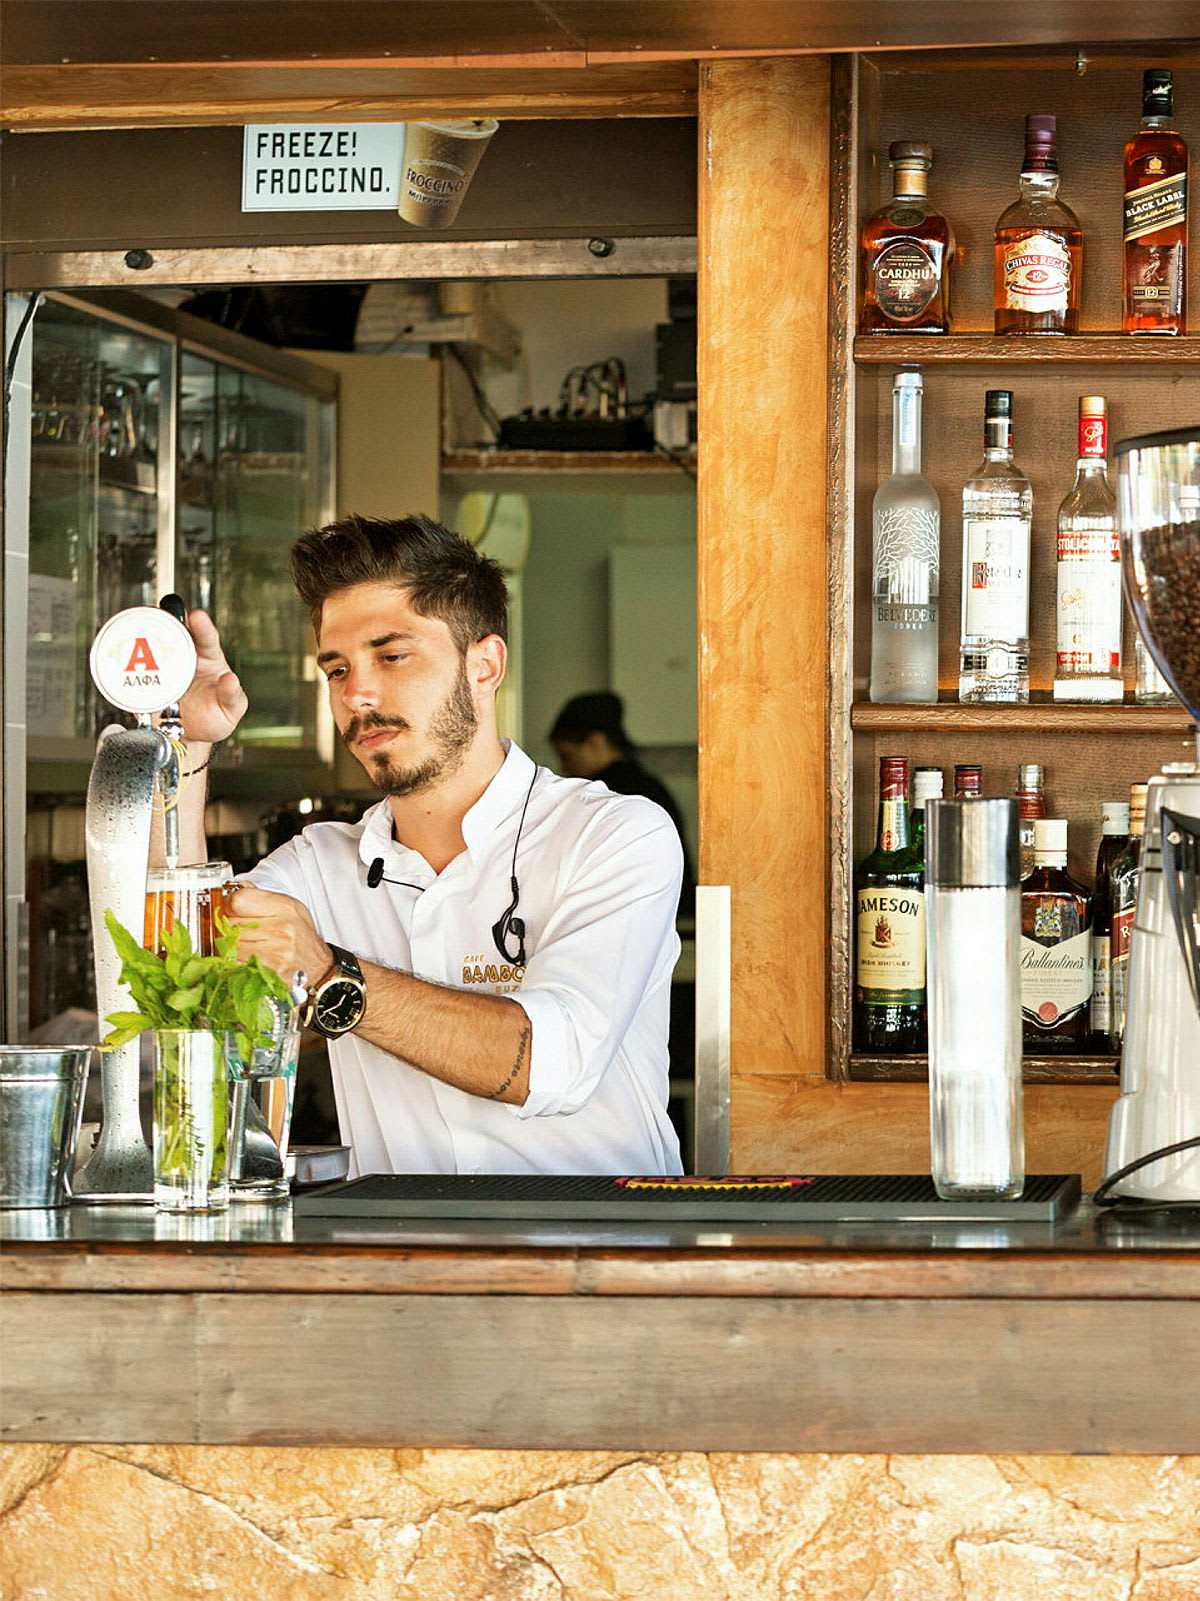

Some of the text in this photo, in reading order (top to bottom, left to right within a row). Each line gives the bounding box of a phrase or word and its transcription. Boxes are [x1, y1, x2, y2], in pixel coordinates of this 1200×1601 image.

[257, 131, 357, 158] FREEZE!
[256, 167, 390, 194] FROCCINO.
[407, 167, 465, 193] FROCCINO
[1126, 201, 1155, 217] BLACK
[1156, 190, 1185, 207] LABEL
[878, 268, 930, 279] CARDHU
[1006, 255, 1070, 271] CHIVAS REGAL
[857, 897, 920, 917] AMESON
